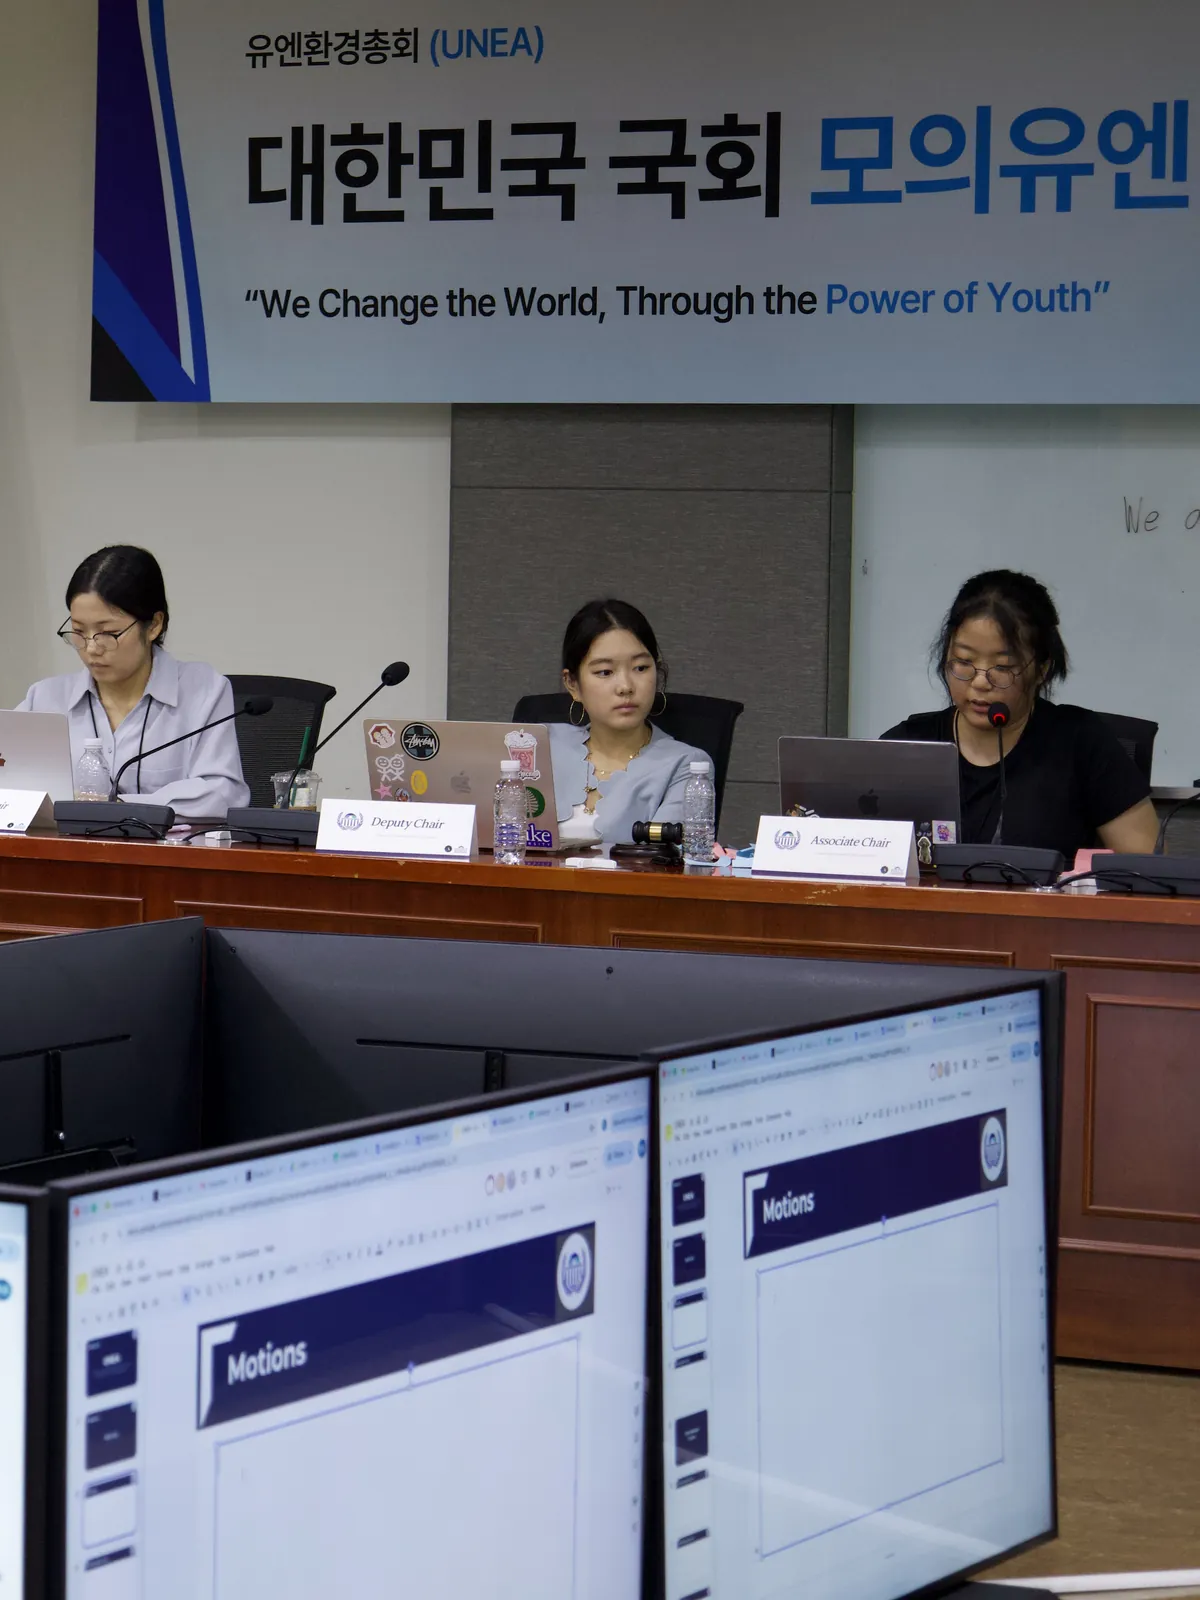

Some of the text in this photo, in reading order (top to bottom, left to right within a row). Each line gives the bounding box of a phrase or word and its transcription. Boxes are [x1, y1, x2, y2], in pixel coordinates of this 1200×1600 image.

[245, 25, 544, 69] 유엔환경총회 (UNEA)
[248, 99, 1190, 226] 대한민국 국회 모의유엔
[245, 280, 1111, 325] “We Change the World, Through the Power of Youth”
[1123, 496, 1160, 534] We
[371, 816, 446, 830] Deputy Chair
[810, 835, 892, 849] Associate Chair
[762, 1187, 815, 1224] Motions
[227, 1338, 308, 1385] Motions
